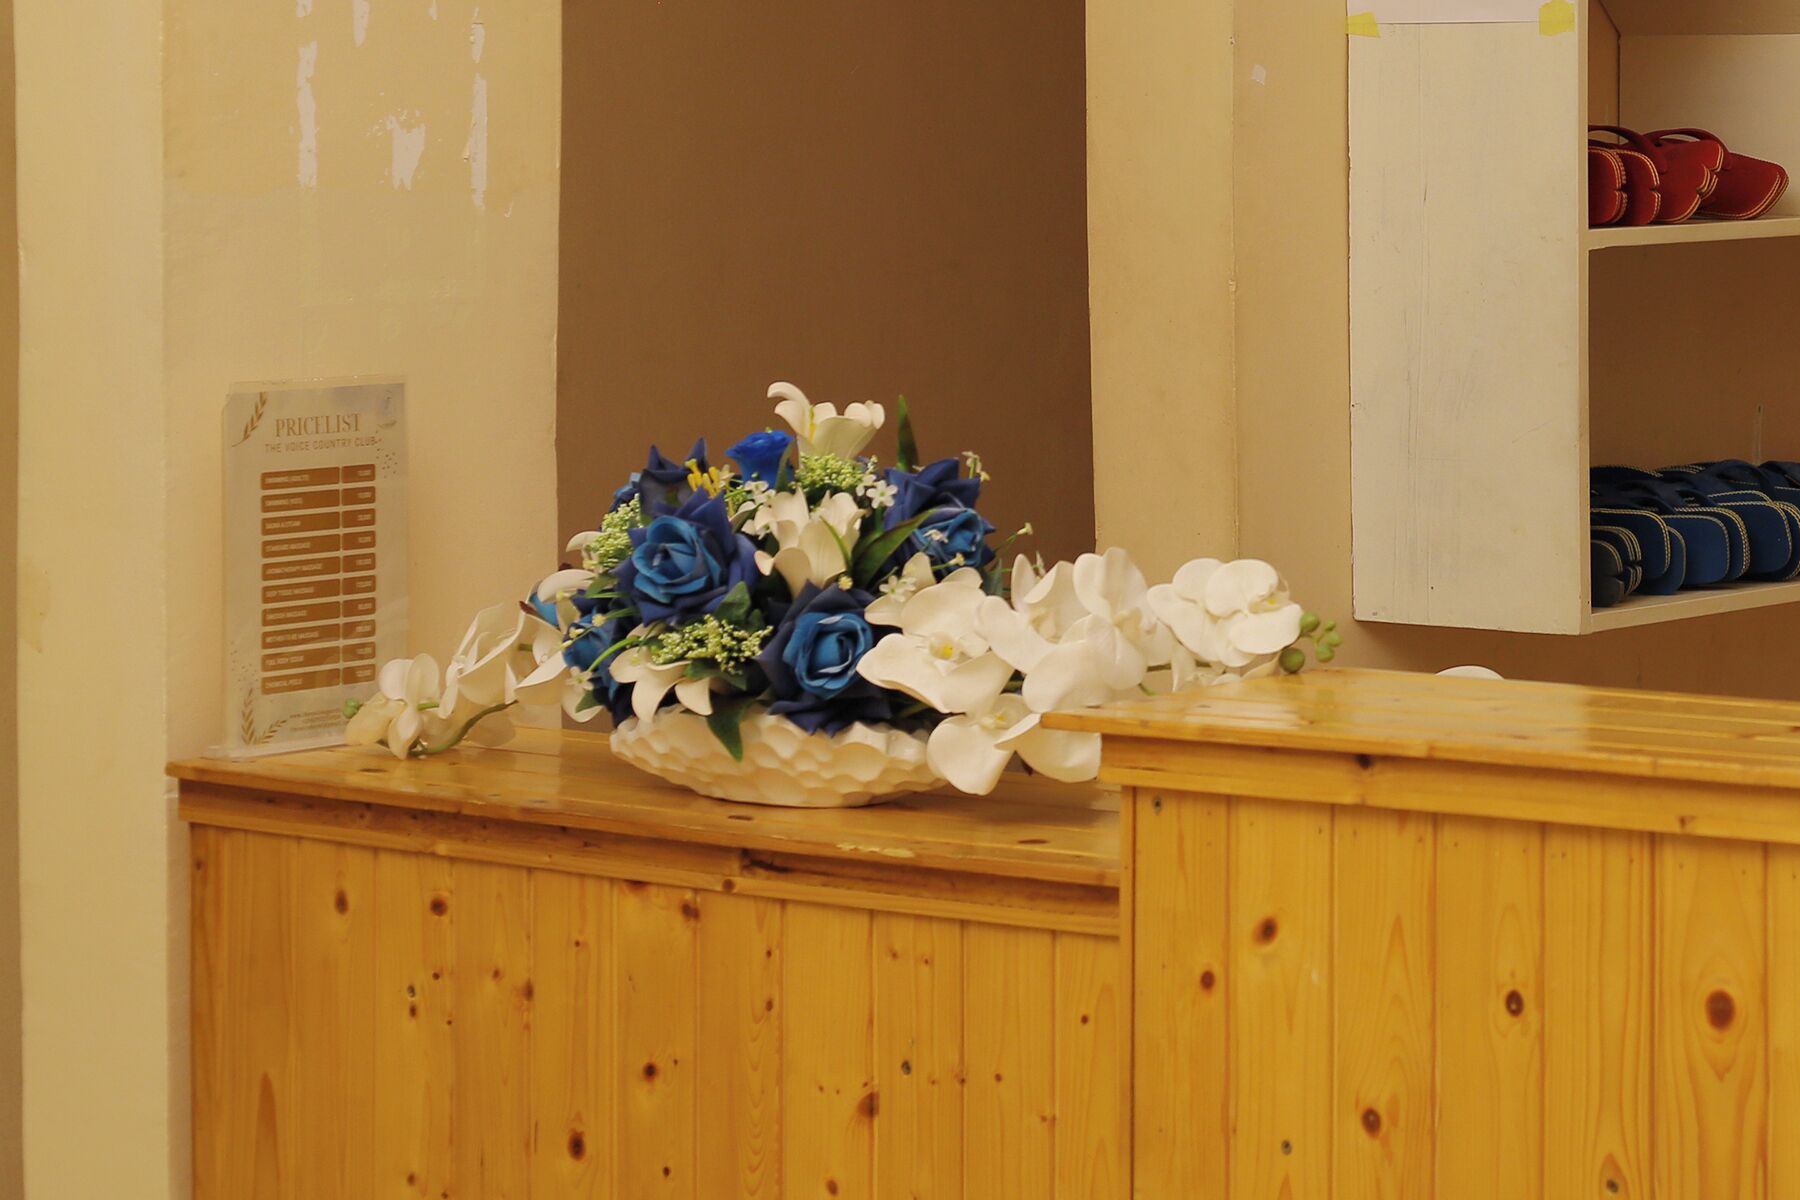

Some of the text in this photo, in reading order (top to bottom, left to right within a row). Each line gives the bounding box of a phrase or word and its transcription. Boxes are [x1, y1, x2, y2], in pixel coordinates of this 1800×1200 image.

[276, 414, 359, 437] PRICELIST
[265, 436, 377, 453] THE VOICE COUNTRY CLUB
